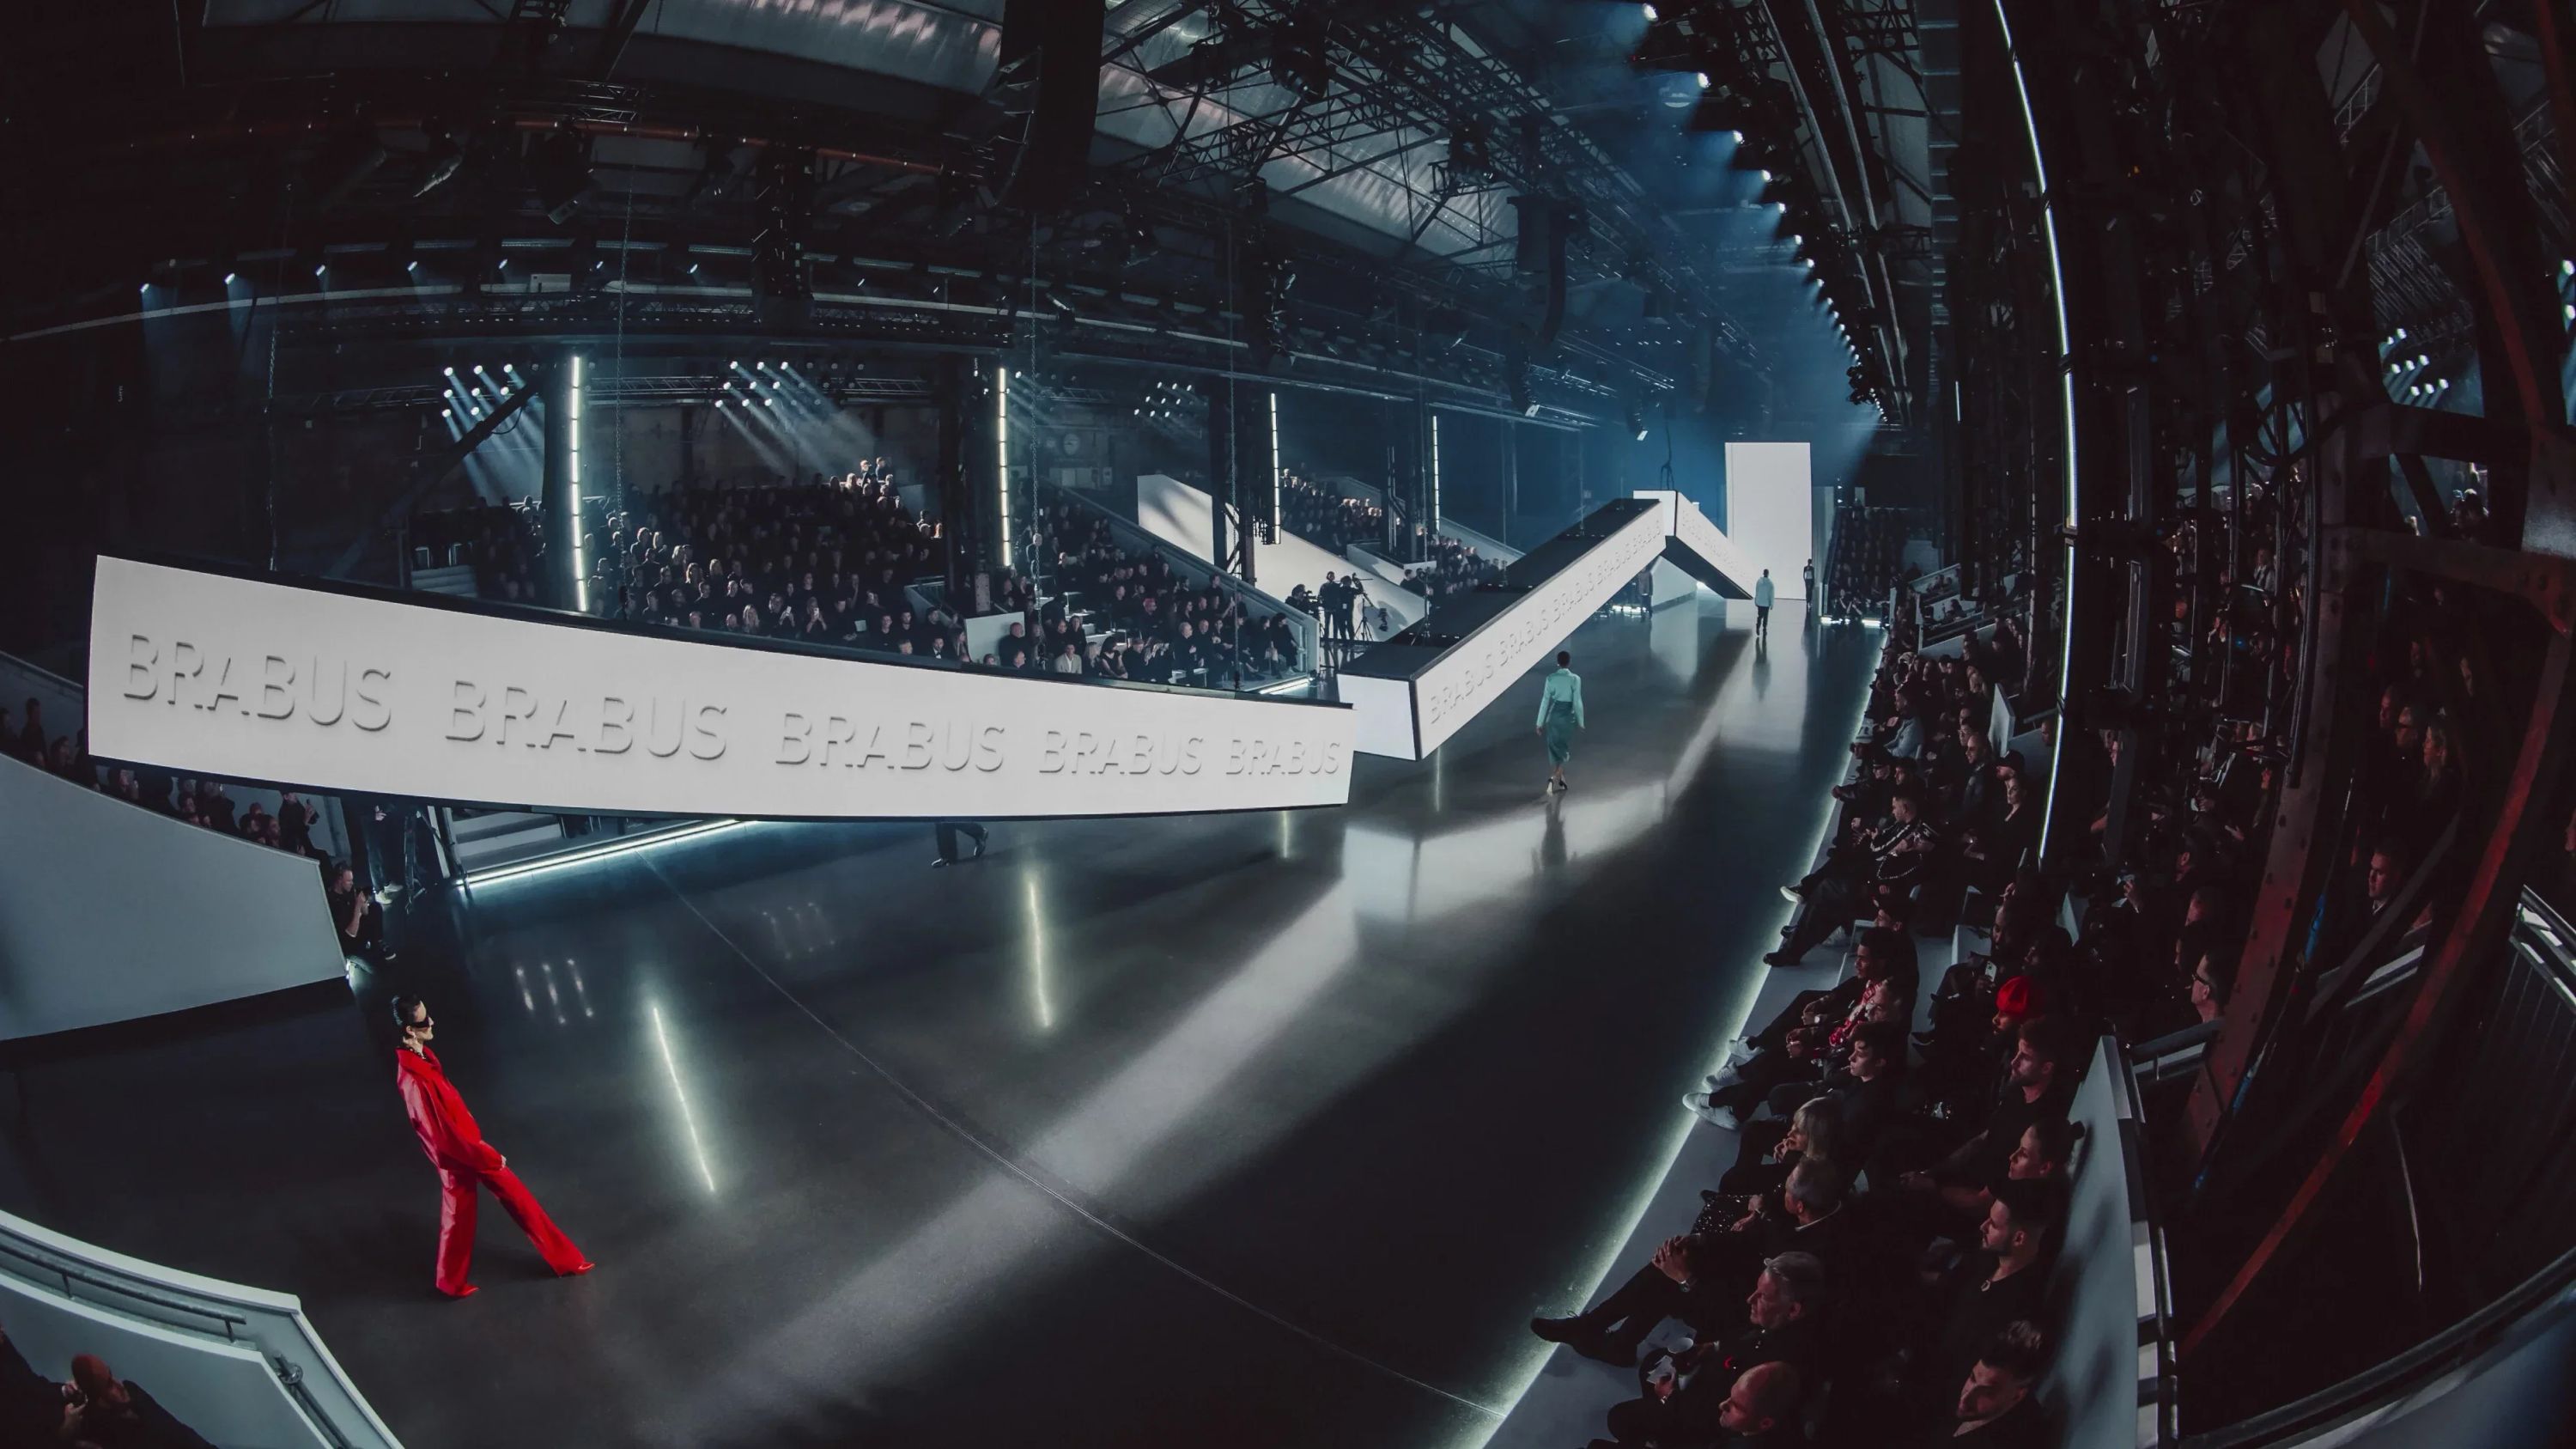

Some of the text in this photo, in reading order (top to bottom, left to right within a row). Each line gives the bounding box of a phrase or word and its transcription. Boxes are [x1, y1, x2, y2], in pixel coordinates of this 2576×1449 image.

[123, 634, 1341, 775] BRABUS BRABUS BRABUS BRABUS BRABUS
[1429, 653, 1494, 725] BRABUS
[1498, 608, 1550, 667] BRABUS
[1552, 572, 1595, 624] BRABUS
